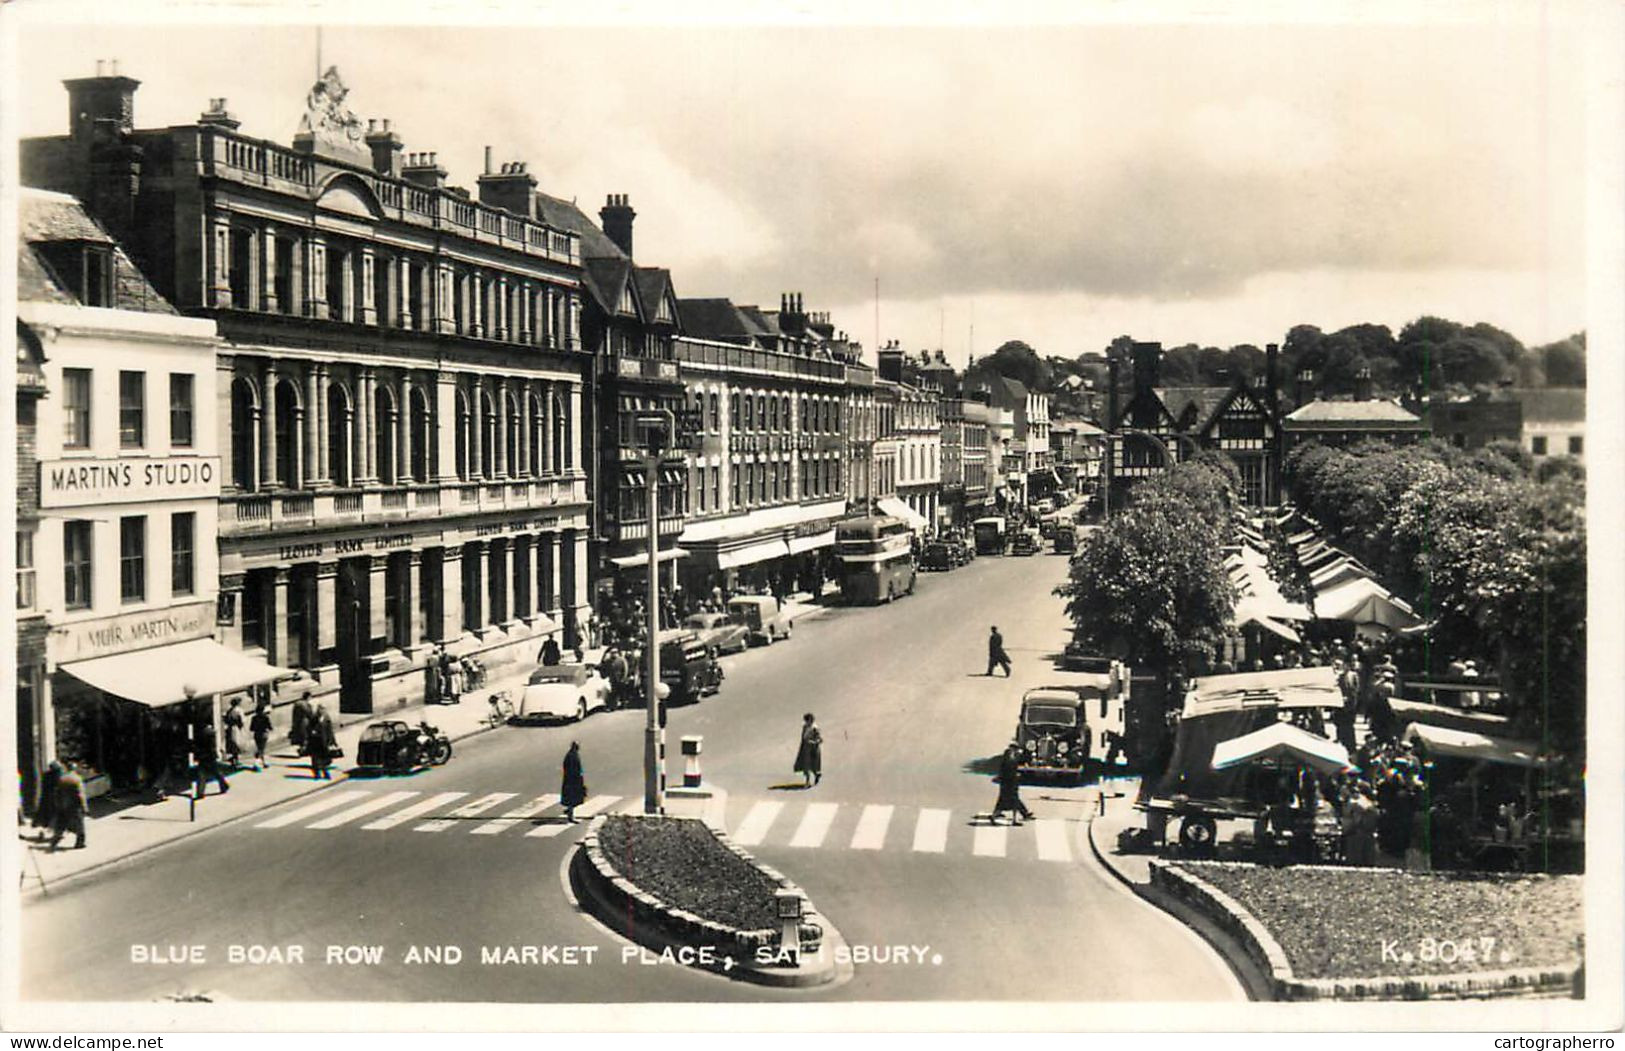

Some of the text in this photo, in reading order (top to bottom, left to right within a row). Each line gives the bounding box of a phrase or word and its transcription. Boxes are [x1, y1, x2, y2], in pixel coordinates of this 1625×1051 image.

[52, 463, 212, 490] MARTIN'S STUDIO
[280, 534, 413, 560] LLOYDS BANK LIMITED
[88, 625, 123, 648] MUIR
[131, 618, 176, 639] MARTIN
